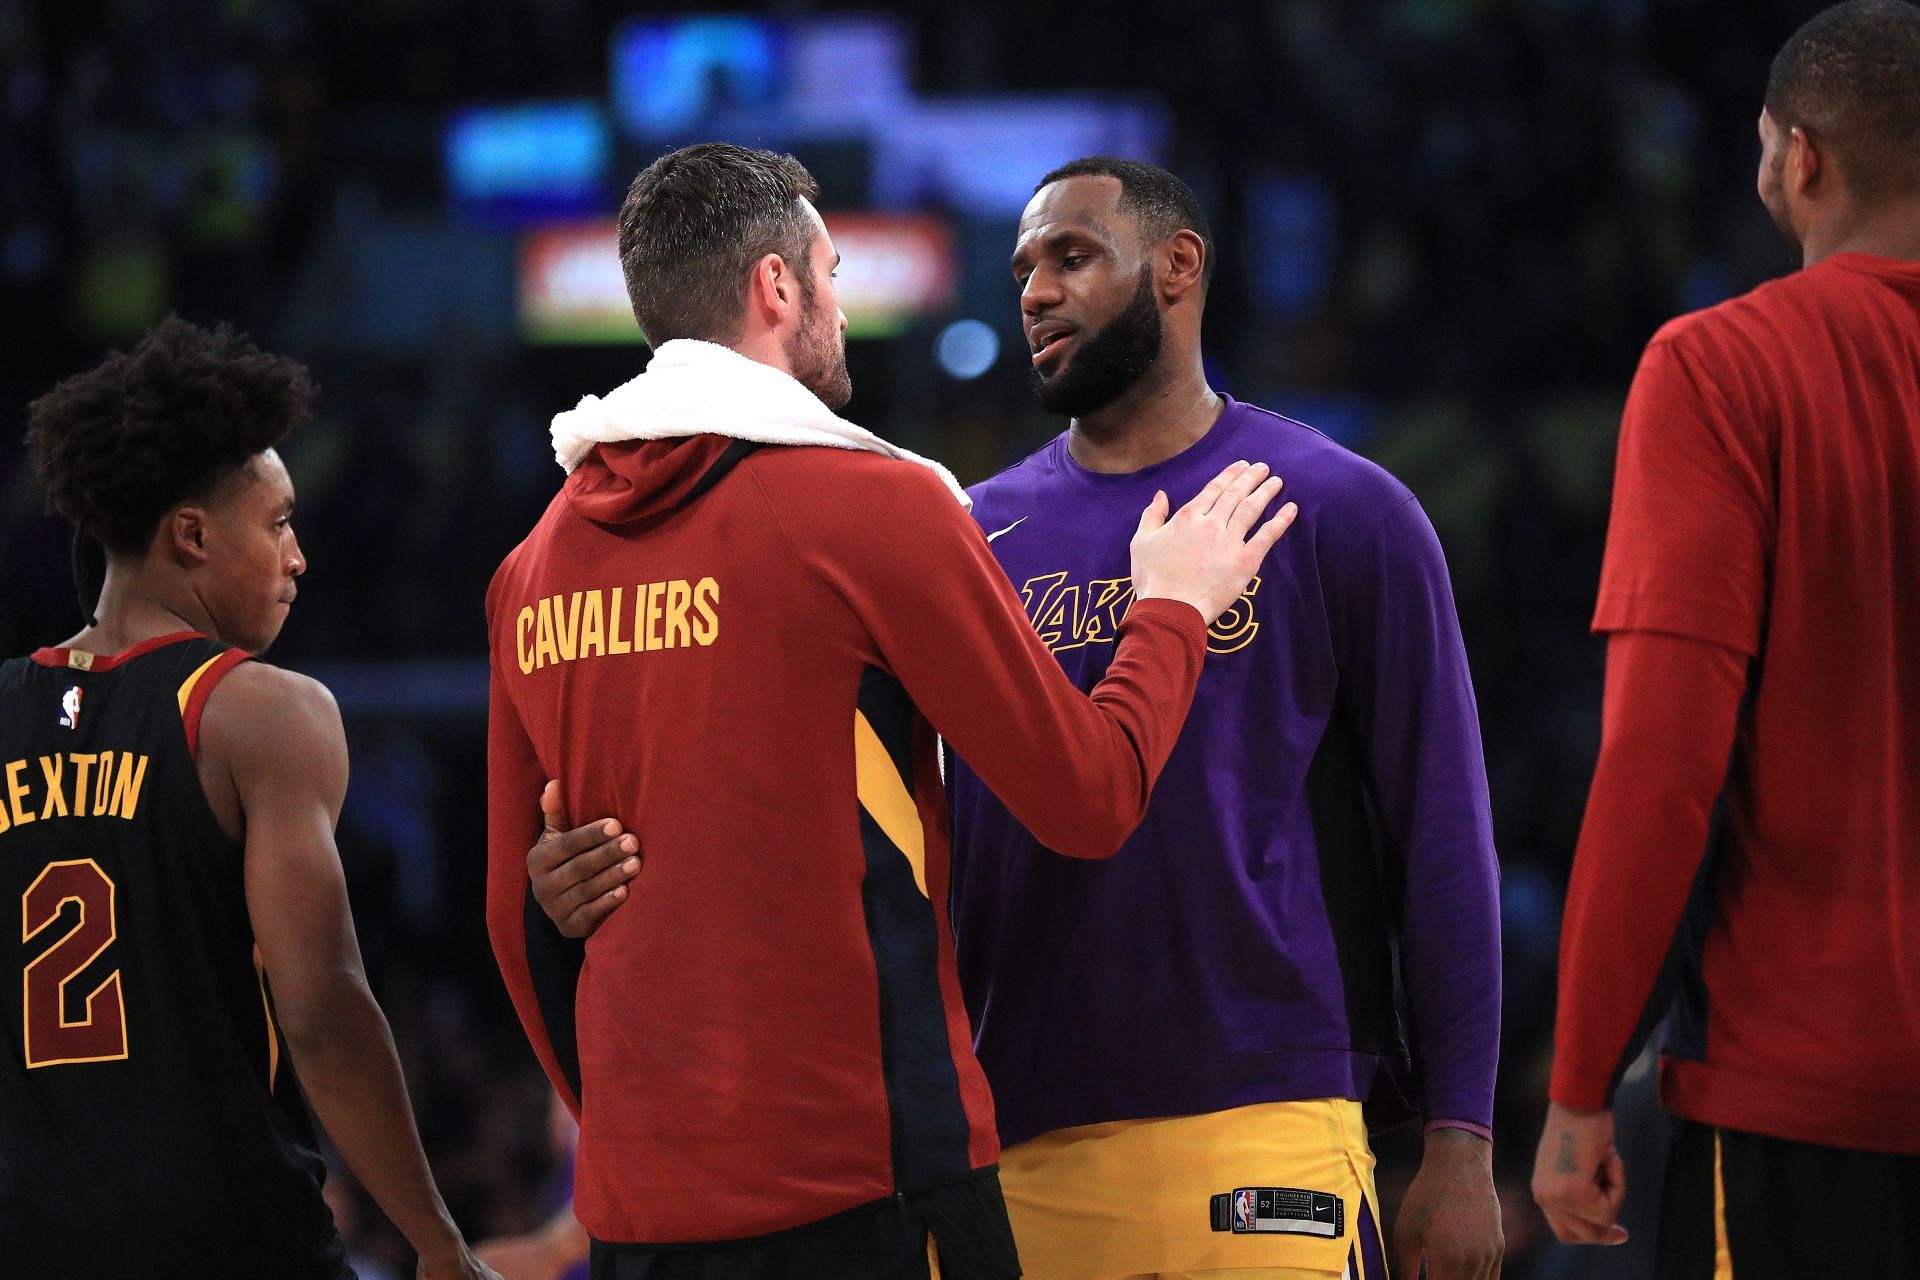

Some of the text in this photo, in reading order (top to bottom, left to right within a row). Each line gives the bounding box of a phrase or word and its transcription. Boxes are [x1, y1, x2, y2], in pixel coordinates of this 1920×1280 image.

[516, 576, 720, 676] CAVALIERS
[1021, 571, 1262, 654] LAKS
[22, 857, 129, 1069] 2
[1260, 1200, 1270, 1208] 52
